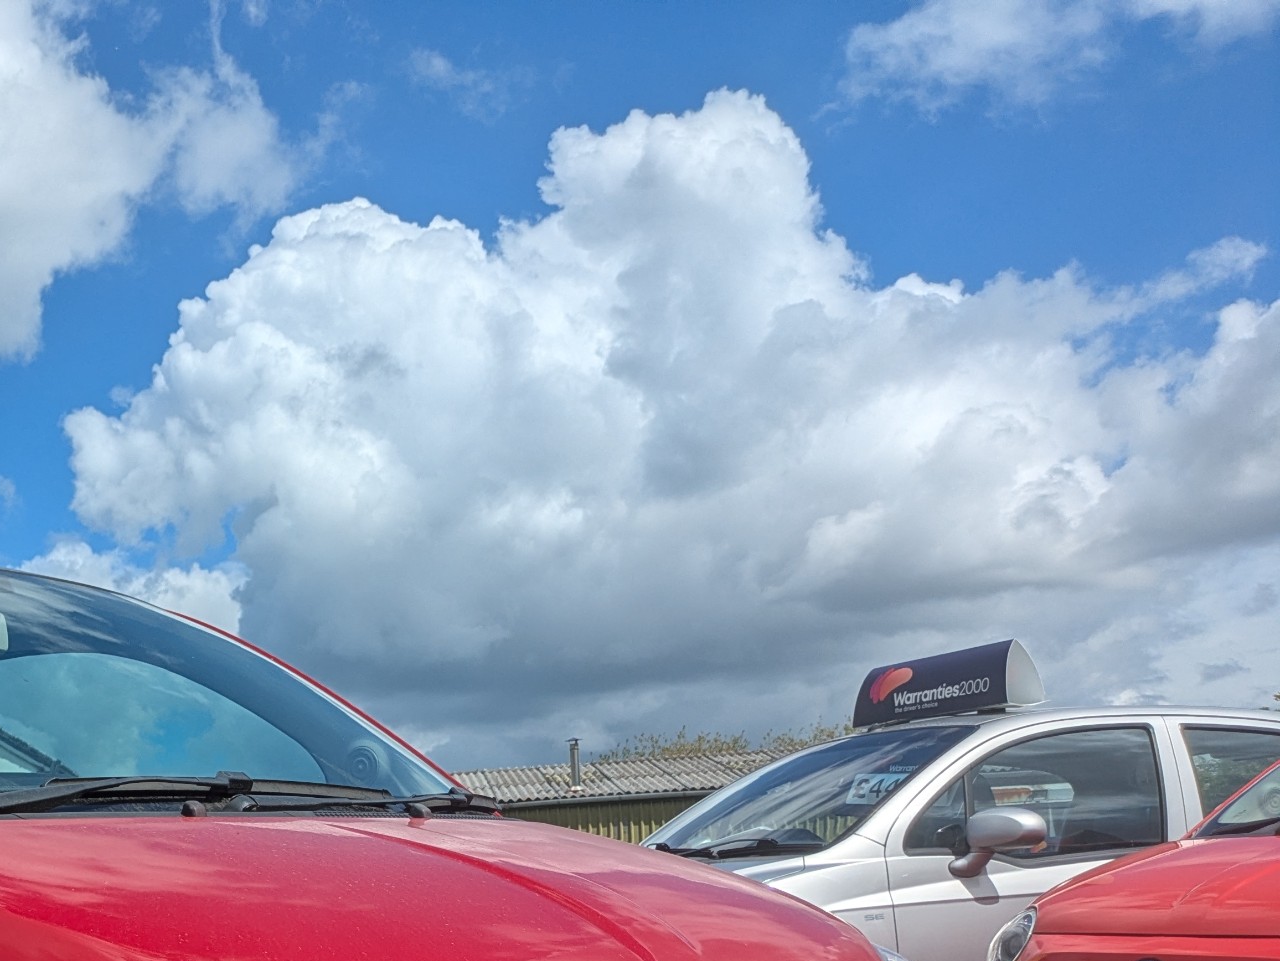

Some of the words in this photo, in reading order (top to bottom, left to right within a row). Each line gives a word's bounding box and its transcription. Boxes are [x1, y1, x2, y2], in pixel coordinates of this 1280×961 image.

[893, 677, 990, 706] Warranties2000
[903, 704, 921, 712] driver's
[864, 913, 885, 921] SE
